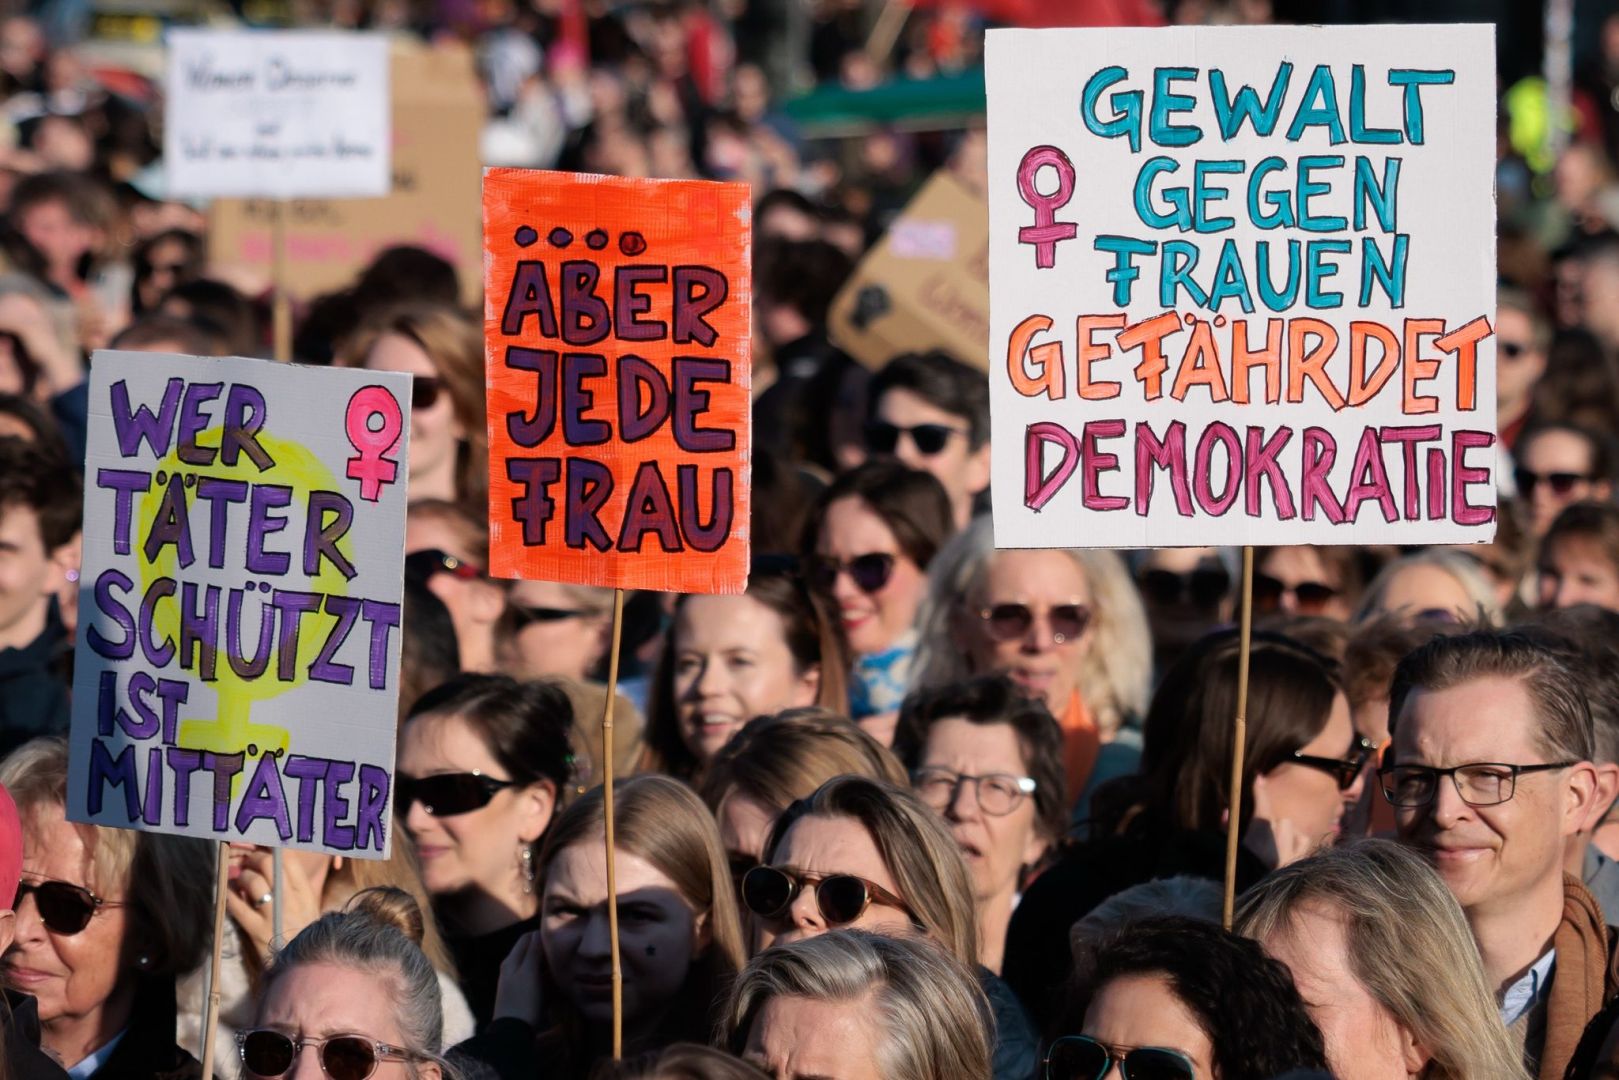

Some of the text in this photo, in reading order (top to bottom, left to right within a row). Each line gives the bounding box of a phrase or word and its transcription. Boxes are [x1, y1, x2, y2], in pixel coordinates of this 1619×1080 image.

[1080, 60, 1454, 152] GEWALT
[1133, 155, 1402, 234] GEGEN
[501, 259, 729, 347] ABER
[1093, 233, 1410, 314] FRAUEN
[506, 346, 736, 453] JEDE
[1006, 311, 1493, 415] GEFÄHRDET
[109, 377, 276, 472] WER
[506, 456, 734, 552] FRAU
[1023, 420, 1496, 526] DEMOKRATIE
[97, 468, 358, 582] TÄTER
[86, 567, 400, 691] SCHÜTZT
[98, 670, 189, 746] IST
[87, 738, 391, 851] MITTÄTER
